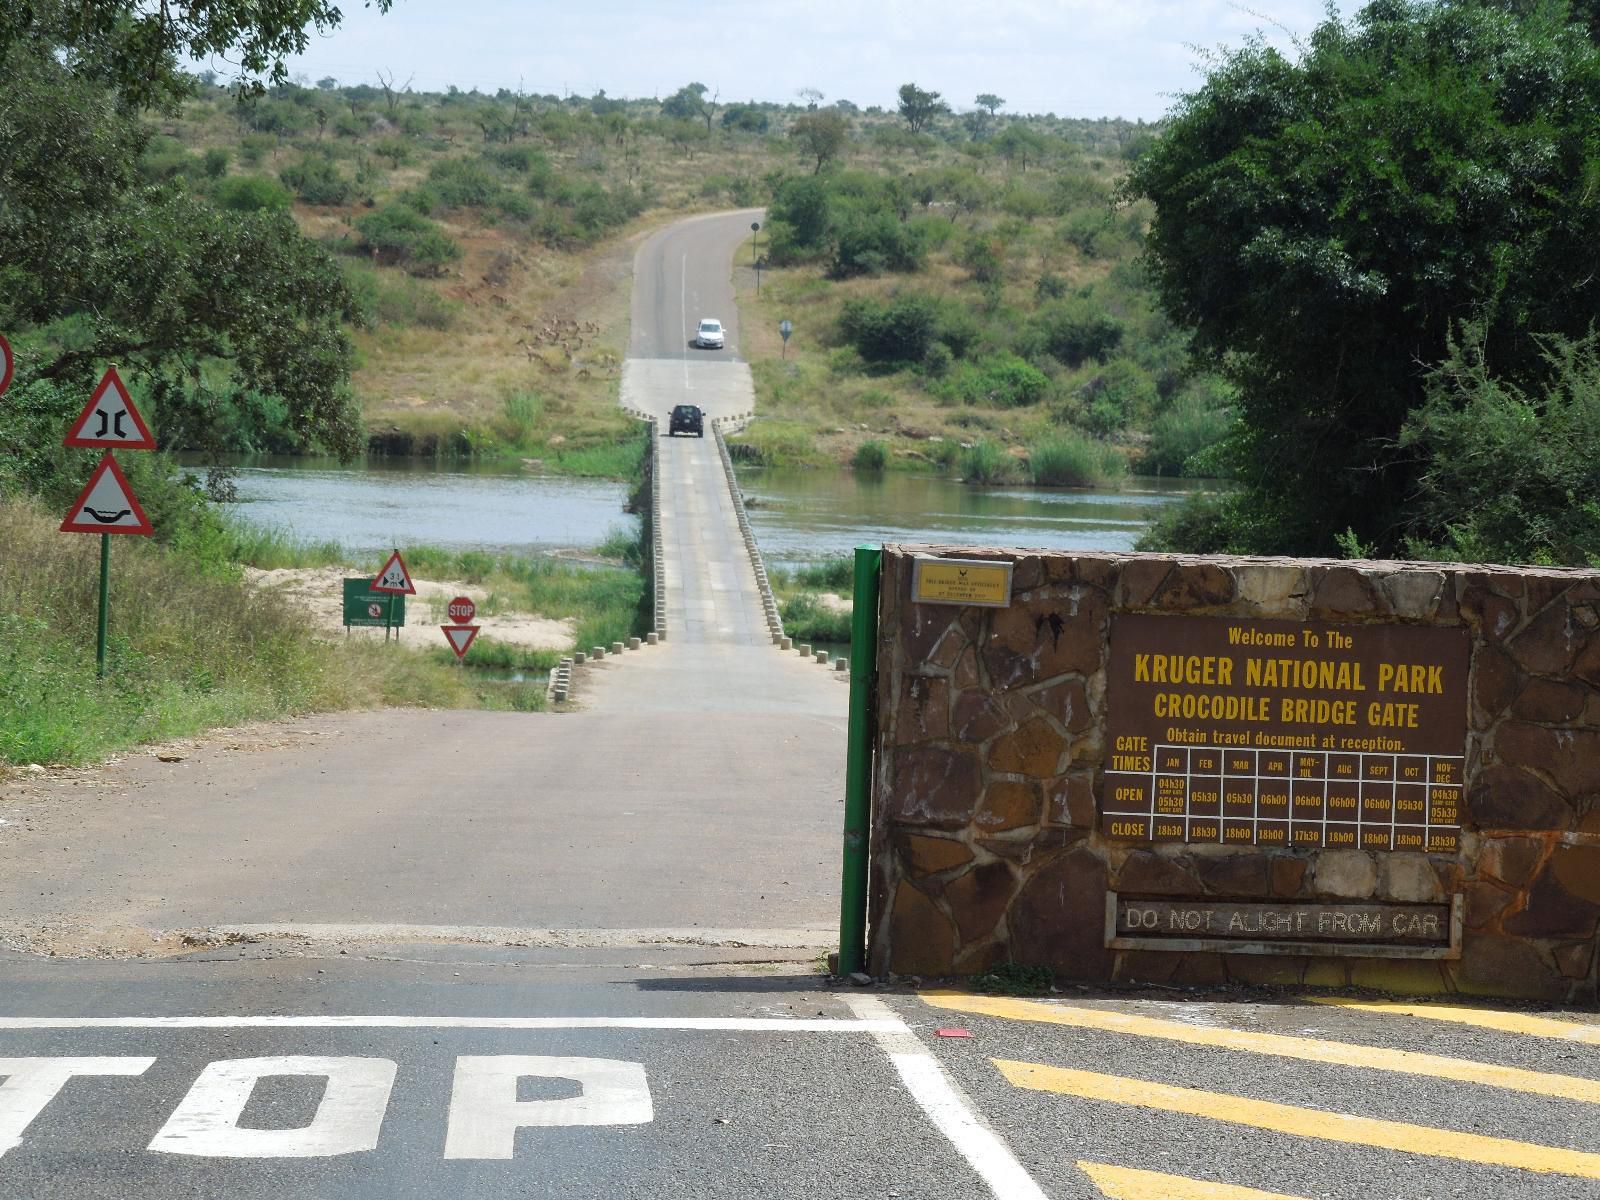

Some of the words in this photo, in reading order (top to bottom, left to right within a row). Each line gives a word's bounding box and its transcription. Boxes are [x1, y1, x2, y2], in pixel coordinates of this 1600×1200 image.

[449, 604, 474, 617] STOP
[1229, 627, 1296, 646] Welcome
[1302, 630, 1319, 648] To
[1326, 631, 1353, 649] The
[1134, 653, 1233, 686] KRUGER
[1246, 658, 1366, 691] NATIONAL
[1378, 663, 1443, 694] PARK
[1154, 692, 1271, 721] CROCODILE
[1281, 698, 1357, 725] BRIDGE
[1368, 702, 1419, 728] GATE
[1116, 736, 1148, 752] GATE
[1167, 727, 1207, 743] Obtain
[1213, 729, 1250, 745] travel
[1255, 731, 1316, 748] document
[1322, 734, 1336, 748] at
[1341, 735, 1405, 752] reception.
[1112, 755, 1151, 771] TIMES
[1166, 758, 1180, 767] JAN
[1199, 759, 1213, 769] FEB
[1233, 760, 1249, 770] MAR
[1268, 762, 1283, 771] APR
[1337, 764, 1352, 774] AUG
[1369, 765, 1389, 776] SEPT
[1404, 767, 1419, 777] OCT
[1299, 768, 1312, 778] JUL
[1436, 774, 1451, 784] DEC
[1159, 778, 1185, 790] 04h30
[1115, 787, 1143, 801] OPEN
[1191, 791, 1217, 803] 05h30
[1226, 793, 1252, 804] 05h30
[1261, 794, 1287, 805] 06h00
[1295, 795, 1321, 807] 06h00
[1329, 796, 1356, 808] 06h00
[1364, 798, 1391, 810] 06h00
[1397, 800, 1423, 811] 05h30
[1158, 796, 1184, 807] 05h30
[1432, 789, 1458, 800] 04h30
[1431, 807, 1457, 818] 05h30
[1111, 822, 1145, 836] CLOSE
[1157, 825, 1182, 836] 18h30
[1192, 826, 1217, 838] 18h30
[1225, 828, 1251, 839] 18h00
[1259, 829, 1284, 840] 18h00
[1294, 830, 1319, 841] 17h30
[1329, 831, 1354, 843] 18h00
[1364, 833, 1389, 844] 18h00
[1396, 834, 1422, 845] 18h00
[1430, 836, 1456, 847] 18h30
[1126, 908, 1158, 929] DO
[1170, 909, 1214, 930] NOT
[1229, 911, 1307, 933] ALIGHT
[1318, 912, 1382, 934] FROM
[1392, 913, 1439, 935] CAR
